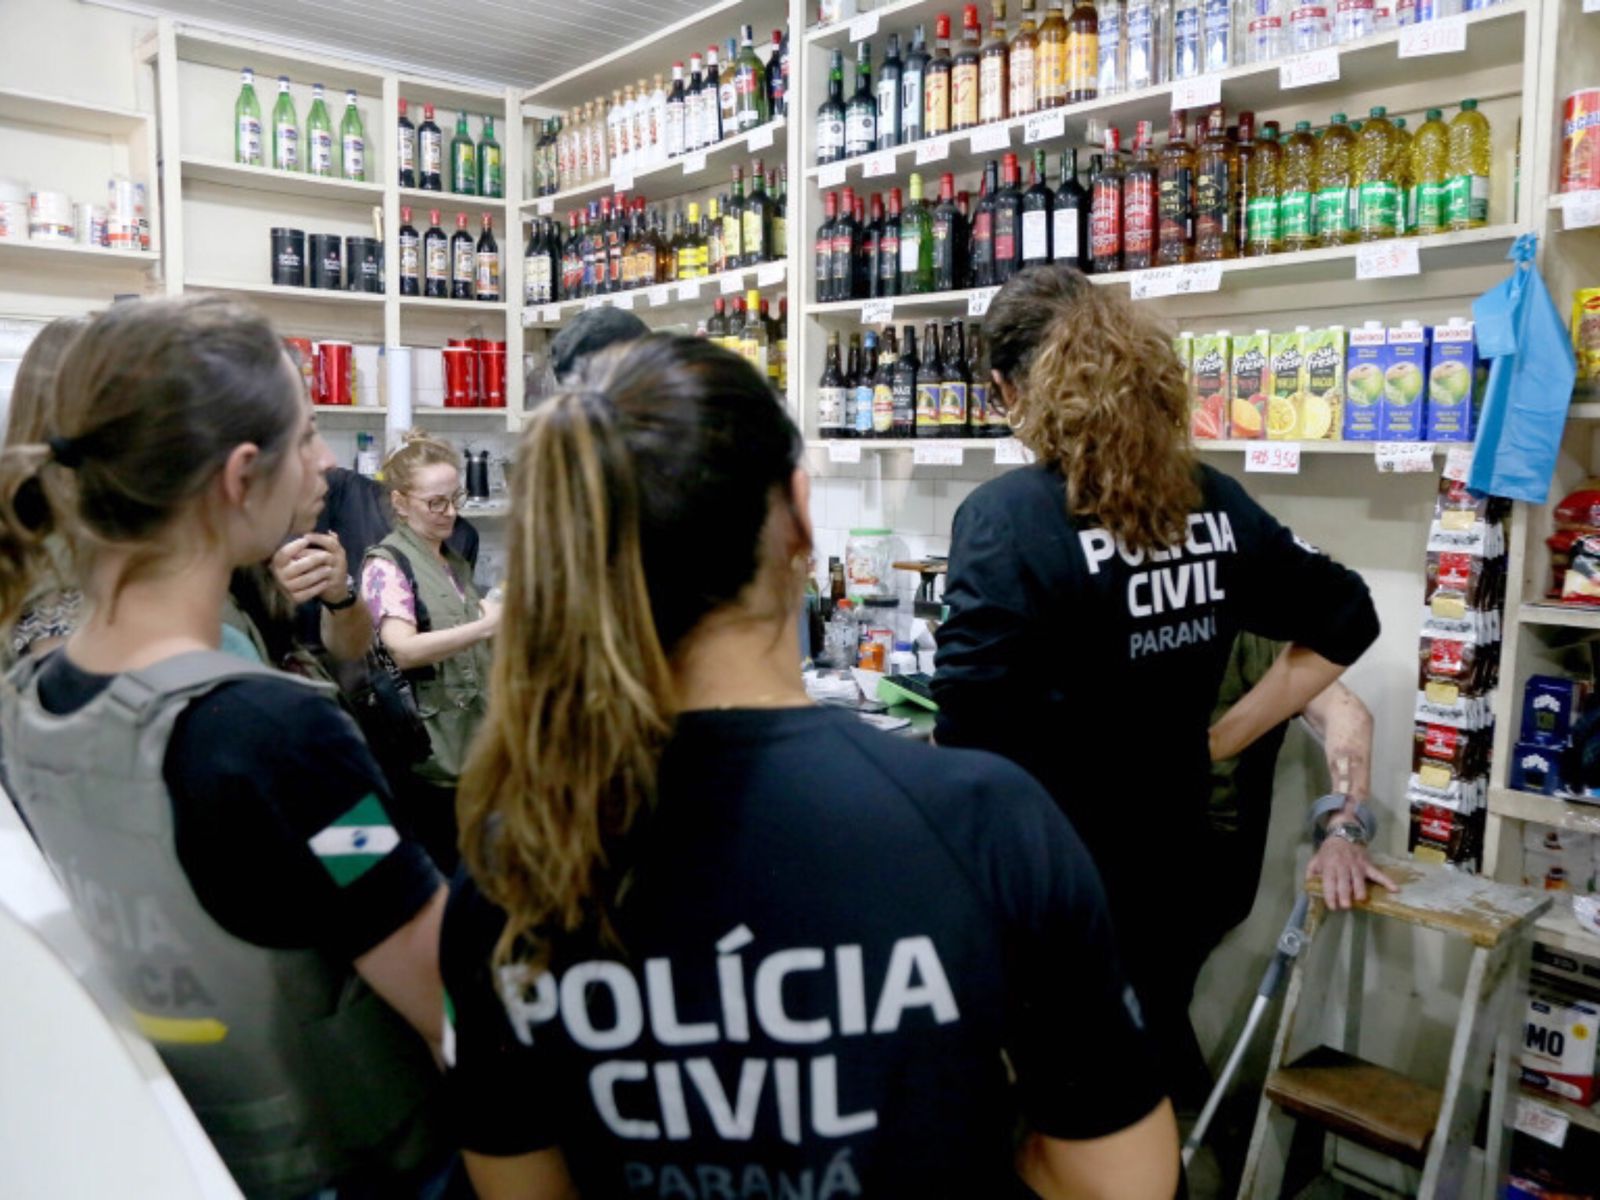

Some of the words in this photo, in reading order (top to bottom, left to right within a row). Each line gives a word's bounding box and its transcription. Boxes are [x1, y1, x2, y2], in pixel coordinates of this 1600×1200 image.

[1127, 559, 1225, 618] CIVIL
[499, 924, 960, 1051] POLÍCIA
[1526, 1022, 1566, 1058] MO
[588, 1055, 878, 1145] CIVIL
[624, 1147, 861, 1200] PARANÁ
